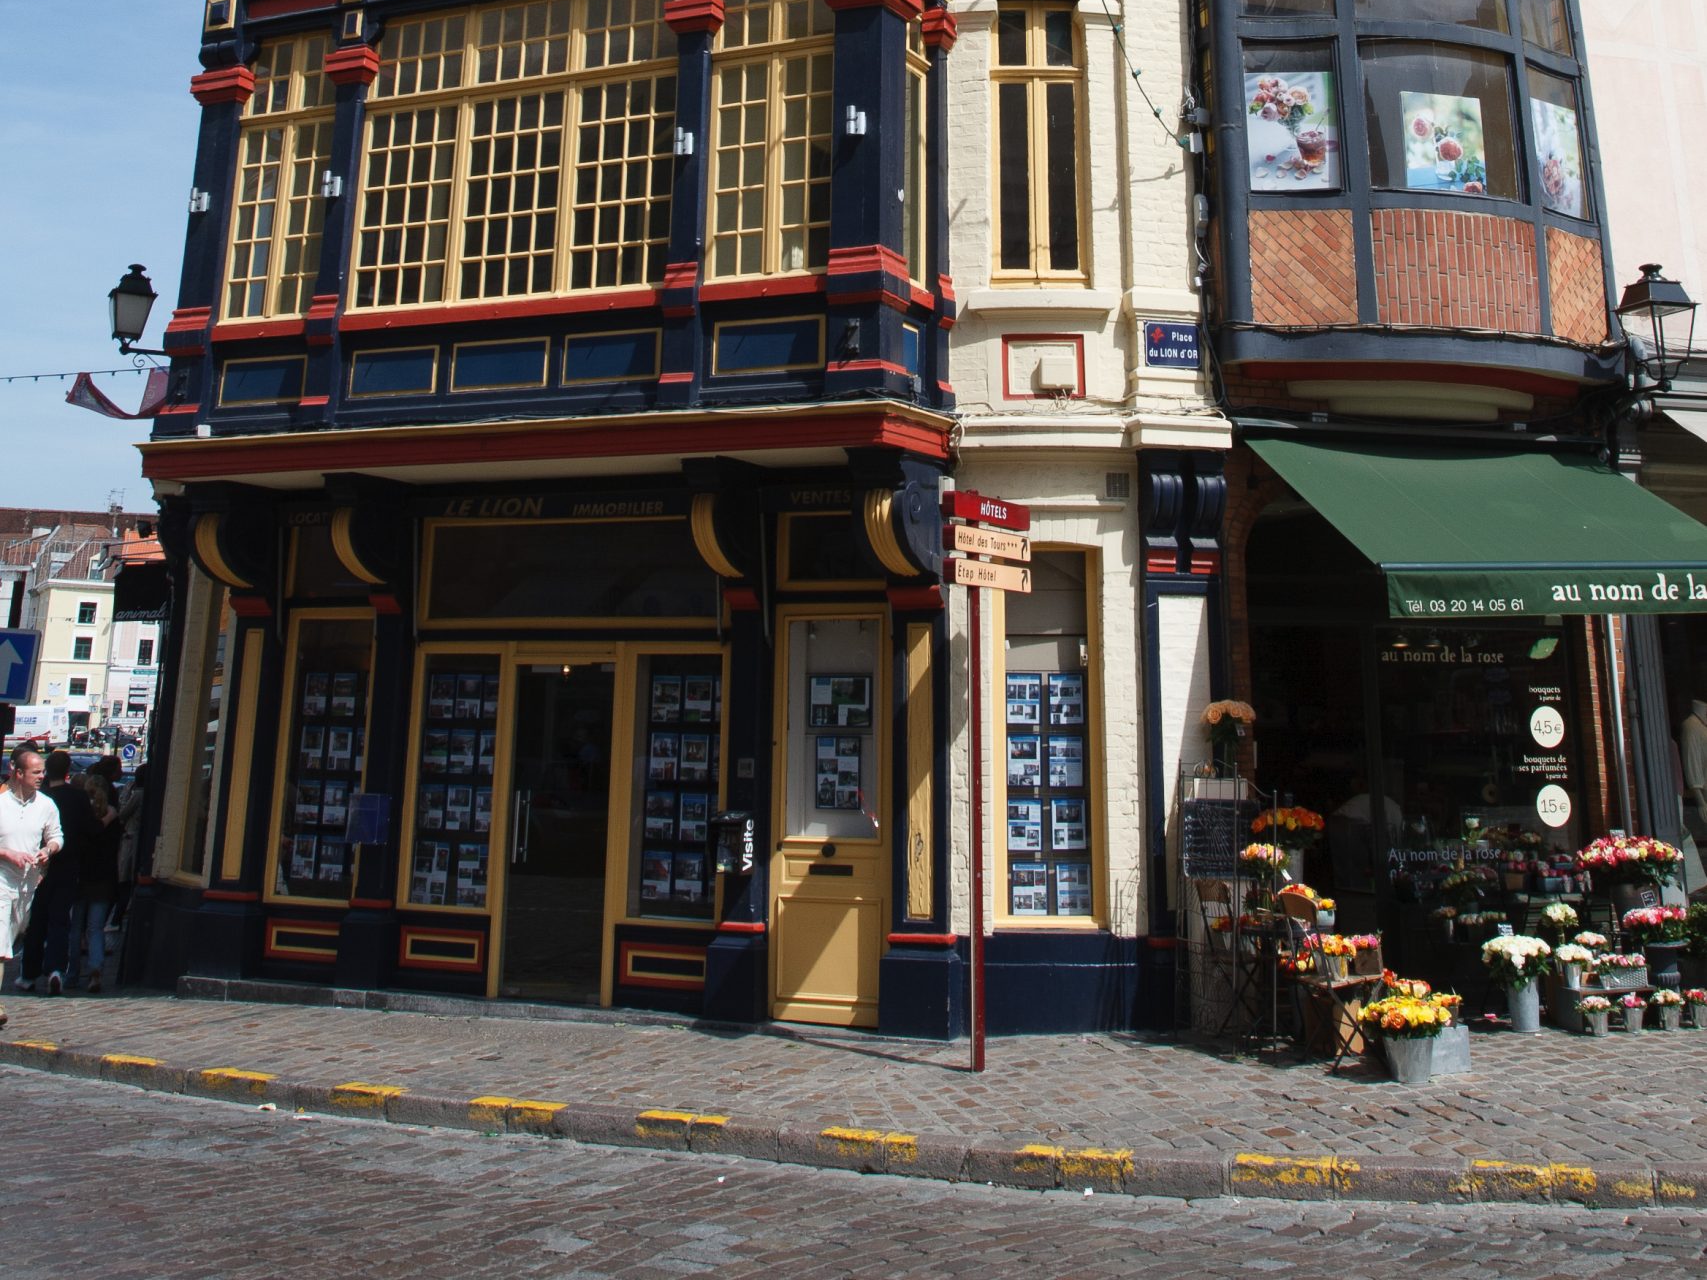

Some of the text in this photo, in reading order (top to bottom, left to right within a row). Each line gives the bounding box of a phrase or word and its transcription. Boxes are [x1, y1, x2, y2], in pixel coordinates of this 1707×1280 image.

[1171, 331, 1193, 342] Place
[1149, 347, 1198, 359] du LION d'OR
[791, 489, 851, 505] VENTES
[445, 496, 664, 518] LE LION IMMOBILIER
[980, 500, 1007, 520] HÔTELS
[288, 511, 331, 526] LOCAT
[957, 531, 975, 545] Hôtel
[977, 536, 988, 548] des
[957, 562, 996, 581] Étap Hôtel
[1551, 573, 1707, 601] au nom de la
[1406, 599, 1525, 613] Tél. 03 20 14 05 61
[1381, 646, 1504, 663] au nom de la rose
[1528, 684, 1561, 696] bouquets
[1523, 754, 1566, 765] bouquets de
[1531, 763, 1568, 773] parfumées
[742, 819, 755, 871] Visite
[1388, 845, 1501, 861] Au nom de la rose
